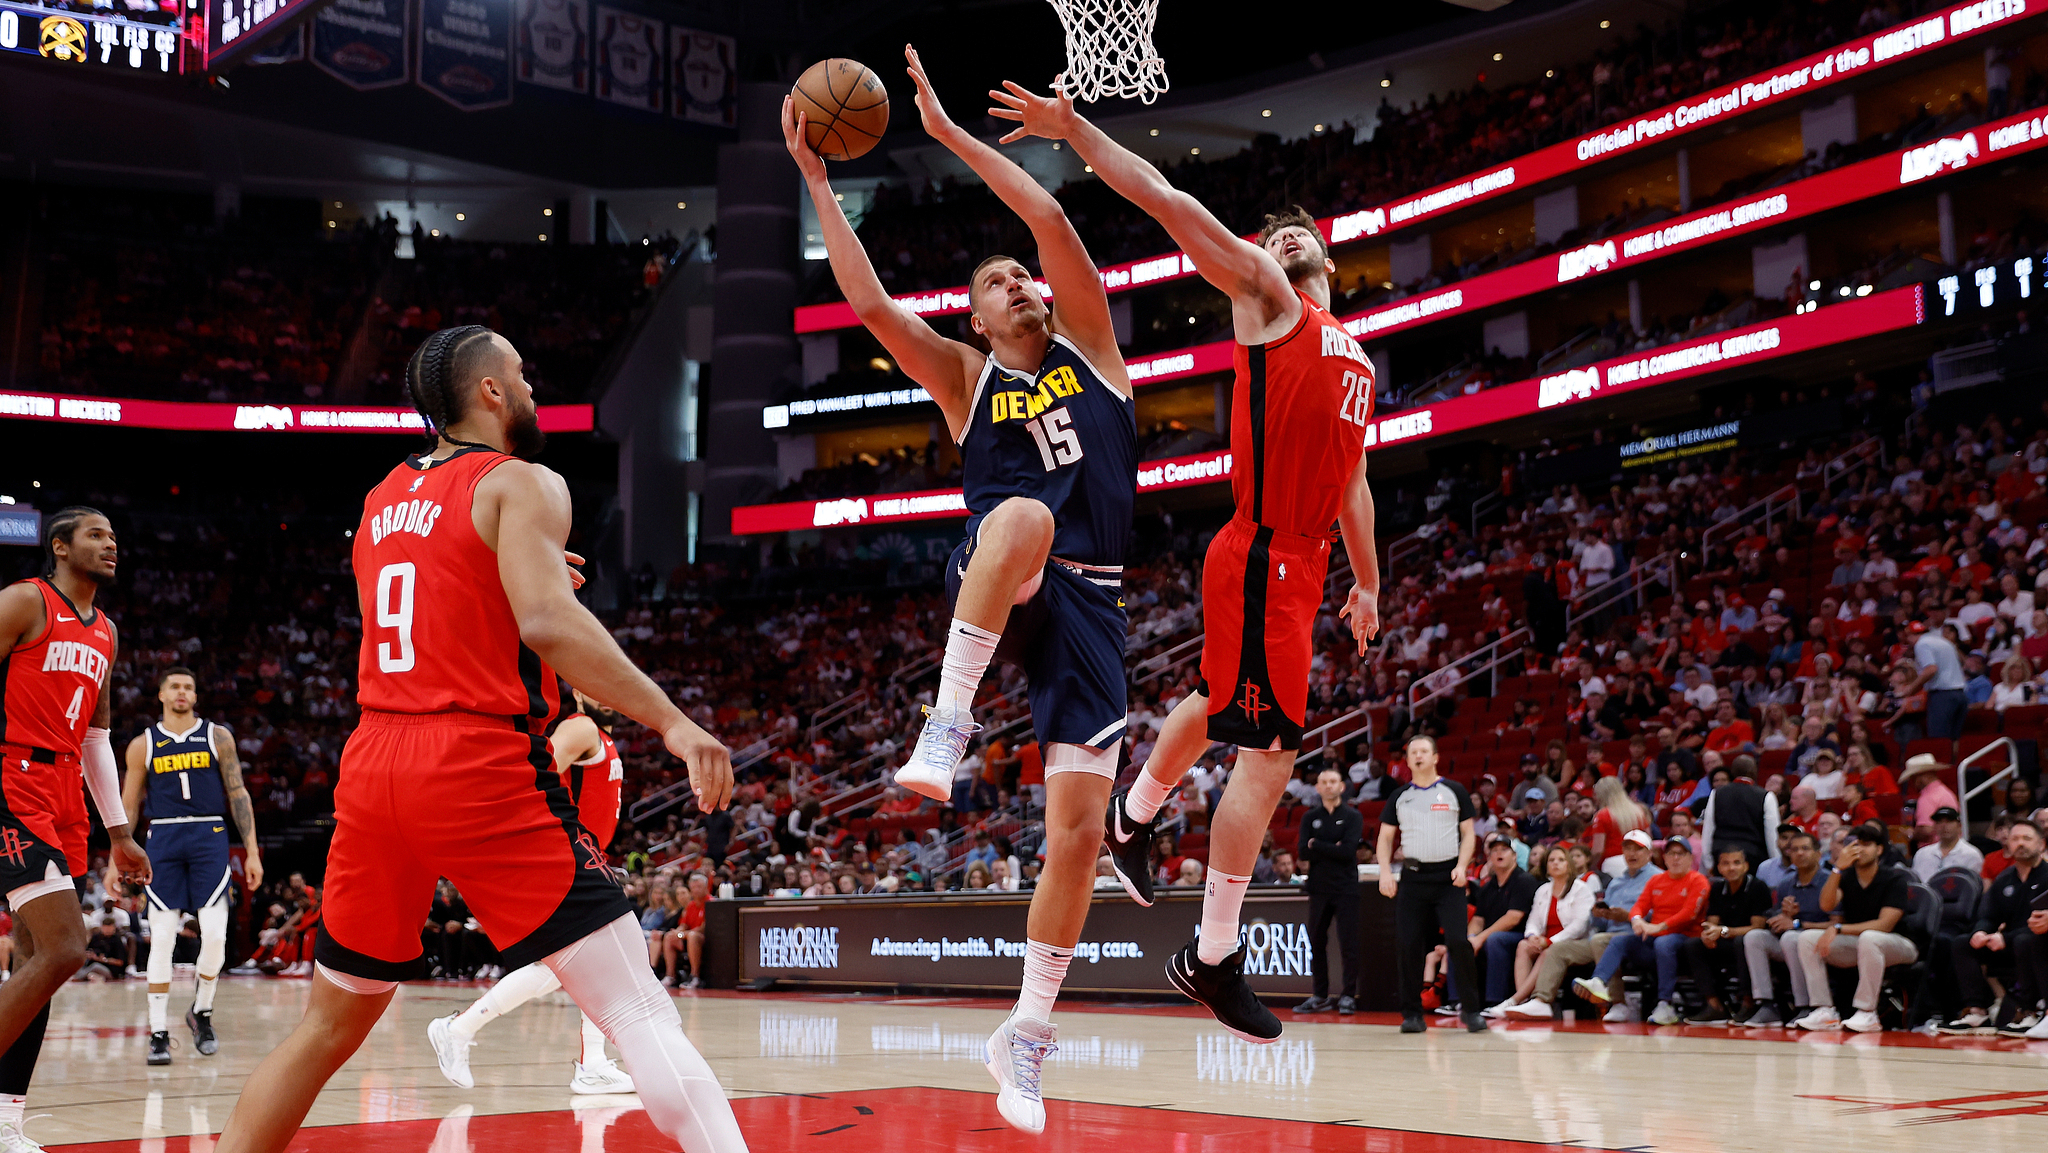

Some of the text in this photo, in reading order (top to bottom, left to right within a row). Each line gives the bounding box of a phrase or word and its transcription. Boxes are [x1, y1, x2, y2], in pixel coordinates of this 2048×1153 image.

[1577, 0, 2026, 161] Official Pest Control Partner of the HOUSTON ROCKETS
[1988, 121, 2031, 151] HOME
[2030, 117, 2043, 139] &
[1390, 201, 1414, 223] HOME
[1414, 199, 1421, 216] &
[1421, 182, 1473, 213] COMMERCIAL
[1473, 167, 1515, 196] SERVICES
[1624, 233, 1655, 258] HOME
[1655, 230, 1664, 249] &
[1663, 210, 1733, 246] COMMERCIAL
[1732, 194, 1788, 226] SERVICES
[1106, 270, 1130, 288] the
[1131, 255, 1180, 284] HOUSTON
[893, 292, 970, 313] fficial Pes
[1360, 317, 1369, 334] &
[1368, 302, 1421, 331] COMMERCIAL
[1420, 289, 1463, 316] SERVICES
[1151, 353, 1194, 376] SERVICES
[1608, 360, 1640, 386] HOME
[1640, 358, 1650, 378] &
[1649, 342, 1723, 375] COMMERCIAL
[1722, 328, 1780, 359] SERVICES
[0, 394, 122, 422] OUSTON ROCKETS
[790, 400, 816, 415] FRED
[816, 395, 863, 413] VANVLEET
[864, 392, 891, 407] WITH
[890, 389, 911, 404] THE
[992, 365, 1084, 424] DENVER
[1340, 370, 1371, 427] 28
[301, 411, 330, 426] HOME
[329, 411, 338, 427] &
[338, 411, 400, 428] COMMERCIAL
[1380, 410, 1432, 443] ROCKETS
[1025, 406, 1084, 472] 15
[1620, 420, 1740, 457] MEMORIAL HERMANN
[1137, 466, 1164, 487] est
[1164, 456, 1222, 483] Control
[371, 499, 442, 546] BROOKS
[874, 499, 901, 516] HOME
[901, 498, 909, 514] &
[377, 562, 416, 673] 9
[42, 641, 109, 690] ROCKETS
[65, 686, 85, 730] 4
[153, 751, 211, 774] DENVER
[178, 772, 191, 800] 1
[759, 926, 839, 950] MEMORIAL
[871, 937, 941, 962] Advancing
[942, 937, 993, 957] health.
[1102, 941, 1144, 958] care.
[759, 947, 839, 968] HERMANN
